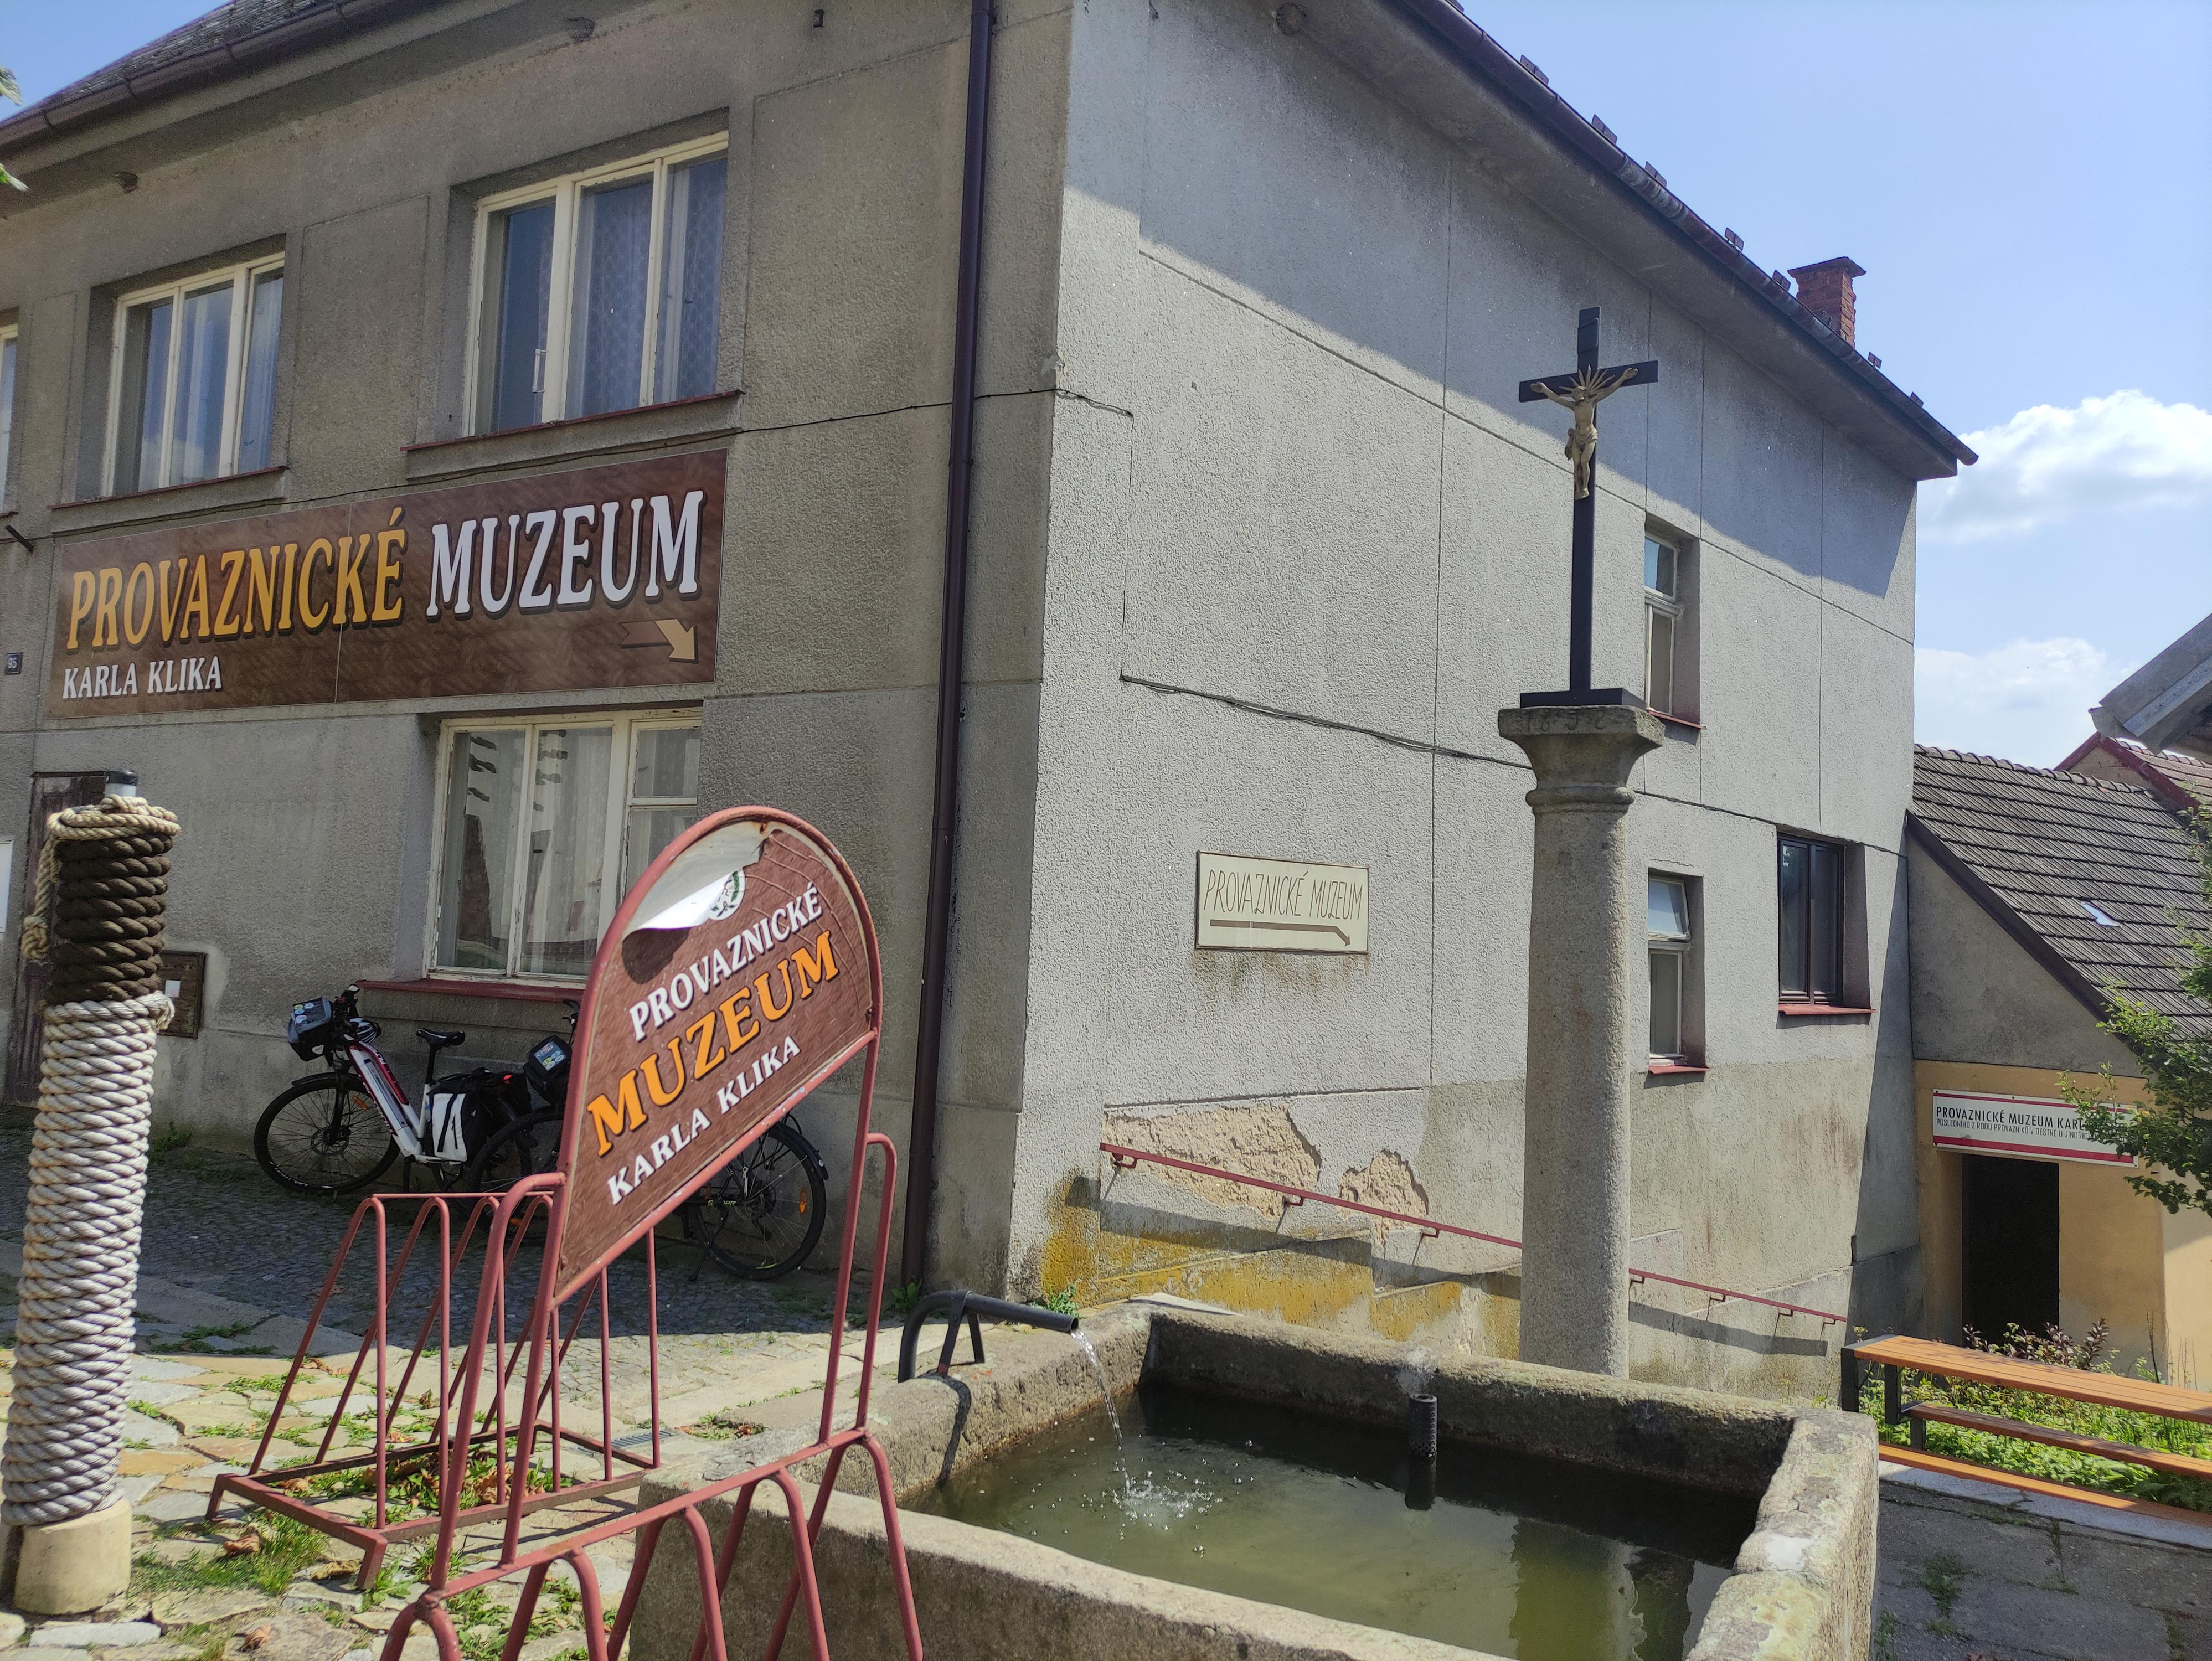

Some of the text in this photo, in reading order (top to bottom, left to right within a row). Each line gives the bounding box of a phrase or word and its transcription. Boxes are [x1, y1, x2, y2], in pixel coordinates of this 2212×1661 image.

[66, 490, 704, 651] PROVAZNICKÉ MUZEUM
[63, 656, 223, 699] KARLA KLIKA
[1203, 870, 1363, 921] PROVAZNICKÉ MUZEUM
[628, 881, 824, 1042] PROVAZNICKÉ
[586, 930, 840, 1157] MUZEUM
[607, 1035, 802, 1206] KARLA KLIKA
[1936, 1106, 2087, 1131] PROVAZNICKÉ MUZEUM KARL
[1936, 1118, 1970, 1129] POSLEDNÍHO
[1977, 1122, 1992, 1131] RODU
[1994, 1123, 2029, 1134] PROVAZNÍKŮ
